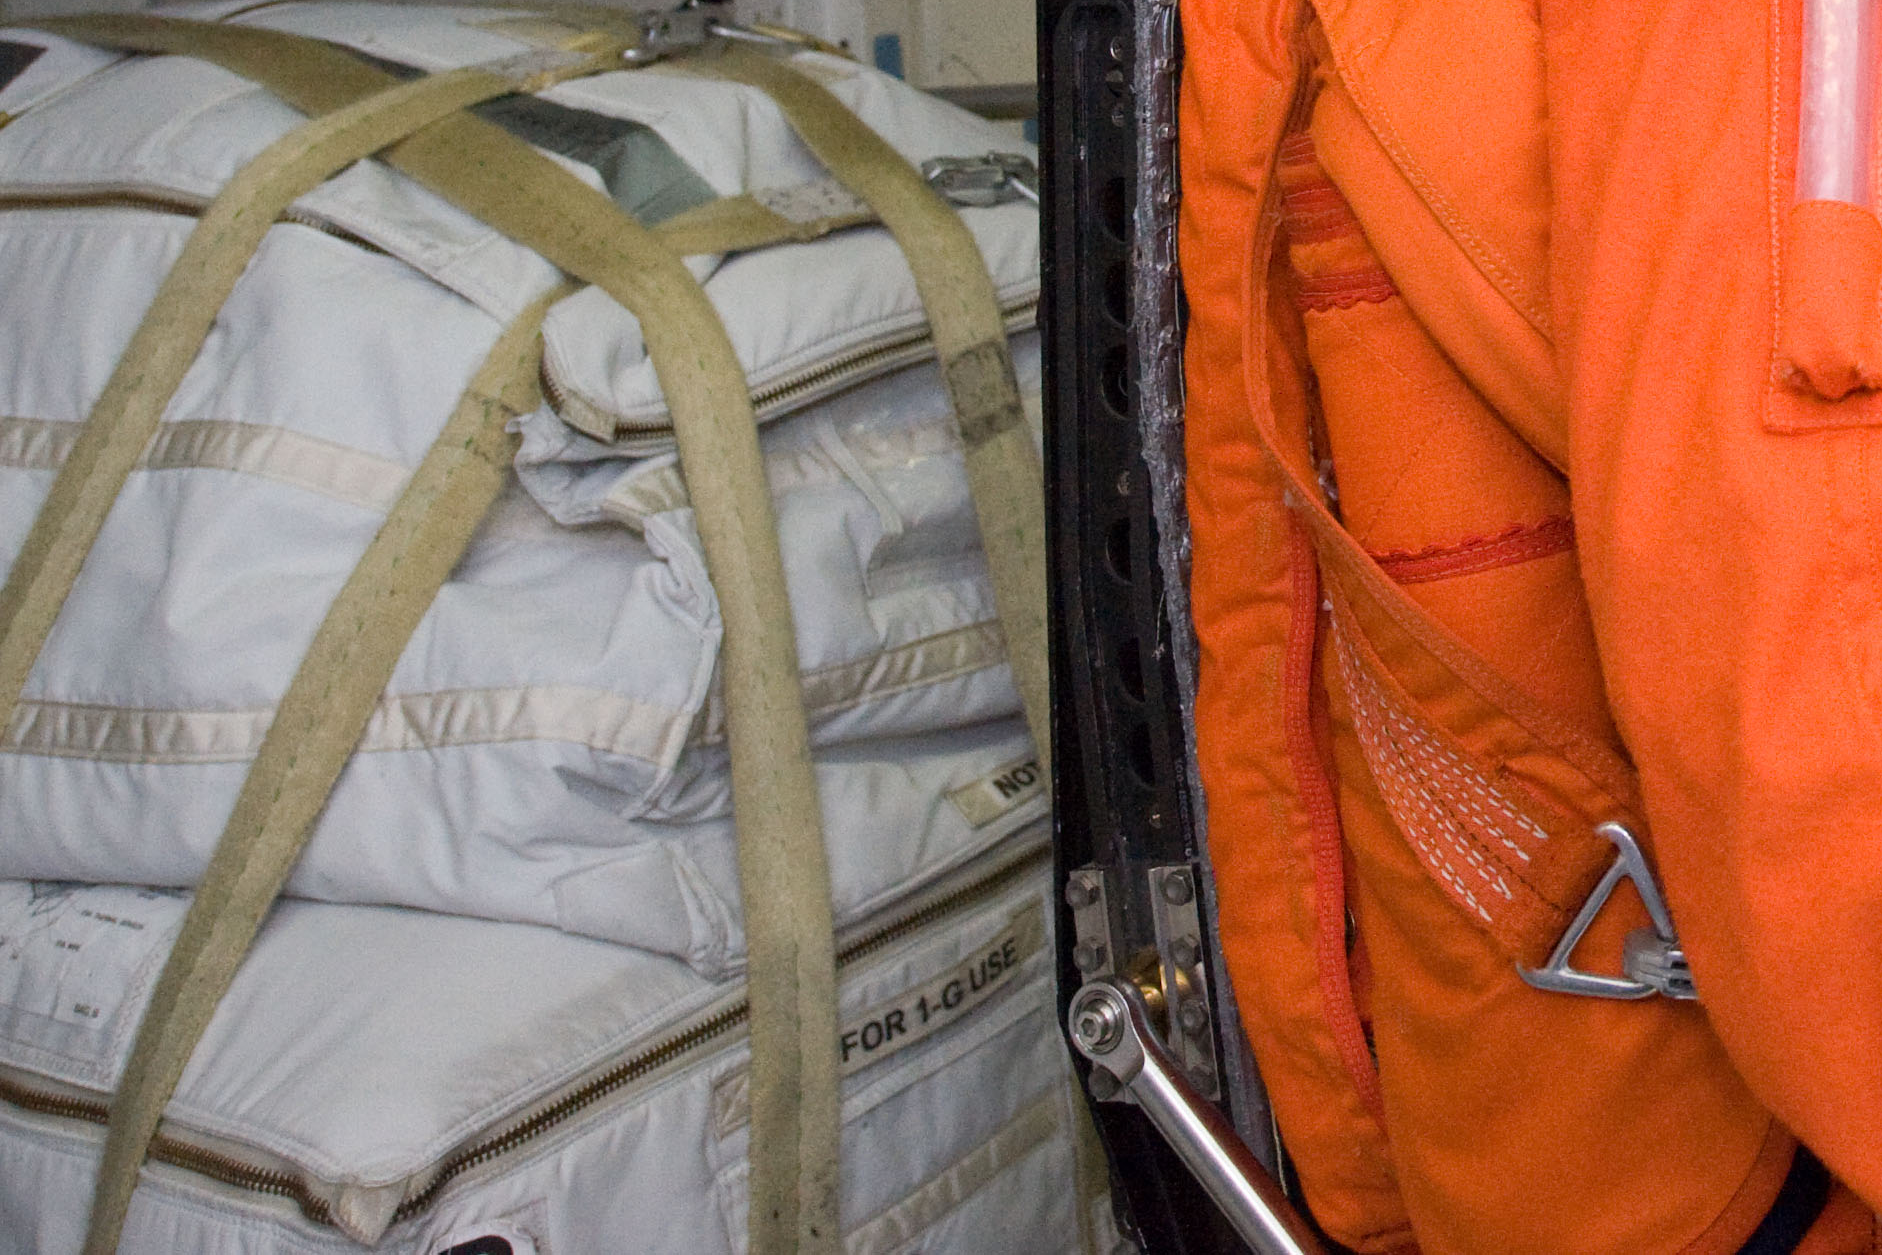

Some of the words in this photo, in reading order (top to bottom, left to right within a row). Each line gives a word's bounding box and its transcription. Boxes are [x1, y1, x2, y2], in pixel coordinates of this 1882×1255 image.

[840, 1009, 906, 1063] FOR
[917, 980, 965, 1024] 1-G
[969, 936, 1019, 993] USE
